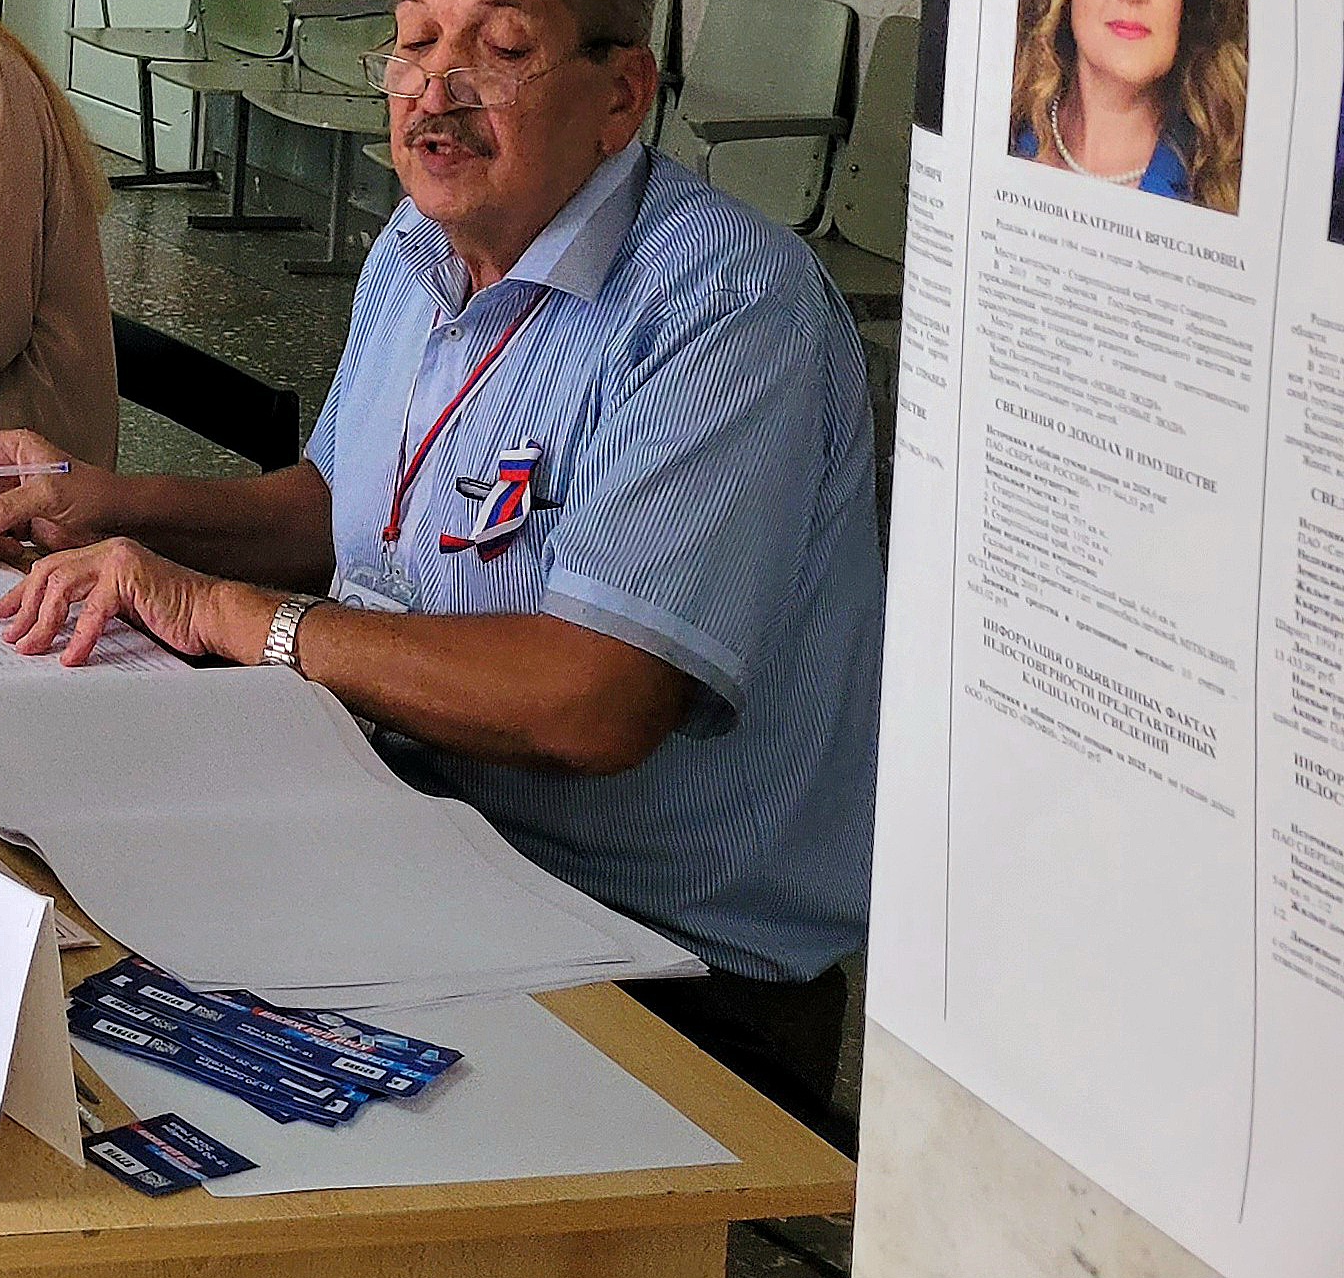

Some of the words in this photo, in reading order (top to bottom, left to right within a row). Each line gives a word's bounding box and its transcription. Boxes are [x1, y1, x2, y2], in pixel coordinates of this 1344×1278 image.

[1072, 210, 1141, 241] ЕКАТЕРИНА
[1145, 230, 1246, 272] ВЯЧЕСЛАВОВНА
[995, 397, 1054, 430] СВЕДЕНИЯ
[1068, 425, 1122, 457] ДОХОДАХ
[1137, 449, 1218, 494] ИМУЩЕСТВЕ
[983, 616, 1062, 665] ИНФОРМАЦИЯ
[1075, 661, 1162, 714] ВЫЯВЛЕННЫХ
[1165, 706, 1217, 740] ФАКТАХ
[983, 634, 1095, 700] НЕДОСТОВЕРНОСТИ
[1097, 692, 1217, 759] ПРЕДСТАВЛЕННЫХ
[1022, 671, 1100, 721] КАНДИДАТОМ
[1102, 711, 1170, 755] СВЕДЕНИЙ
